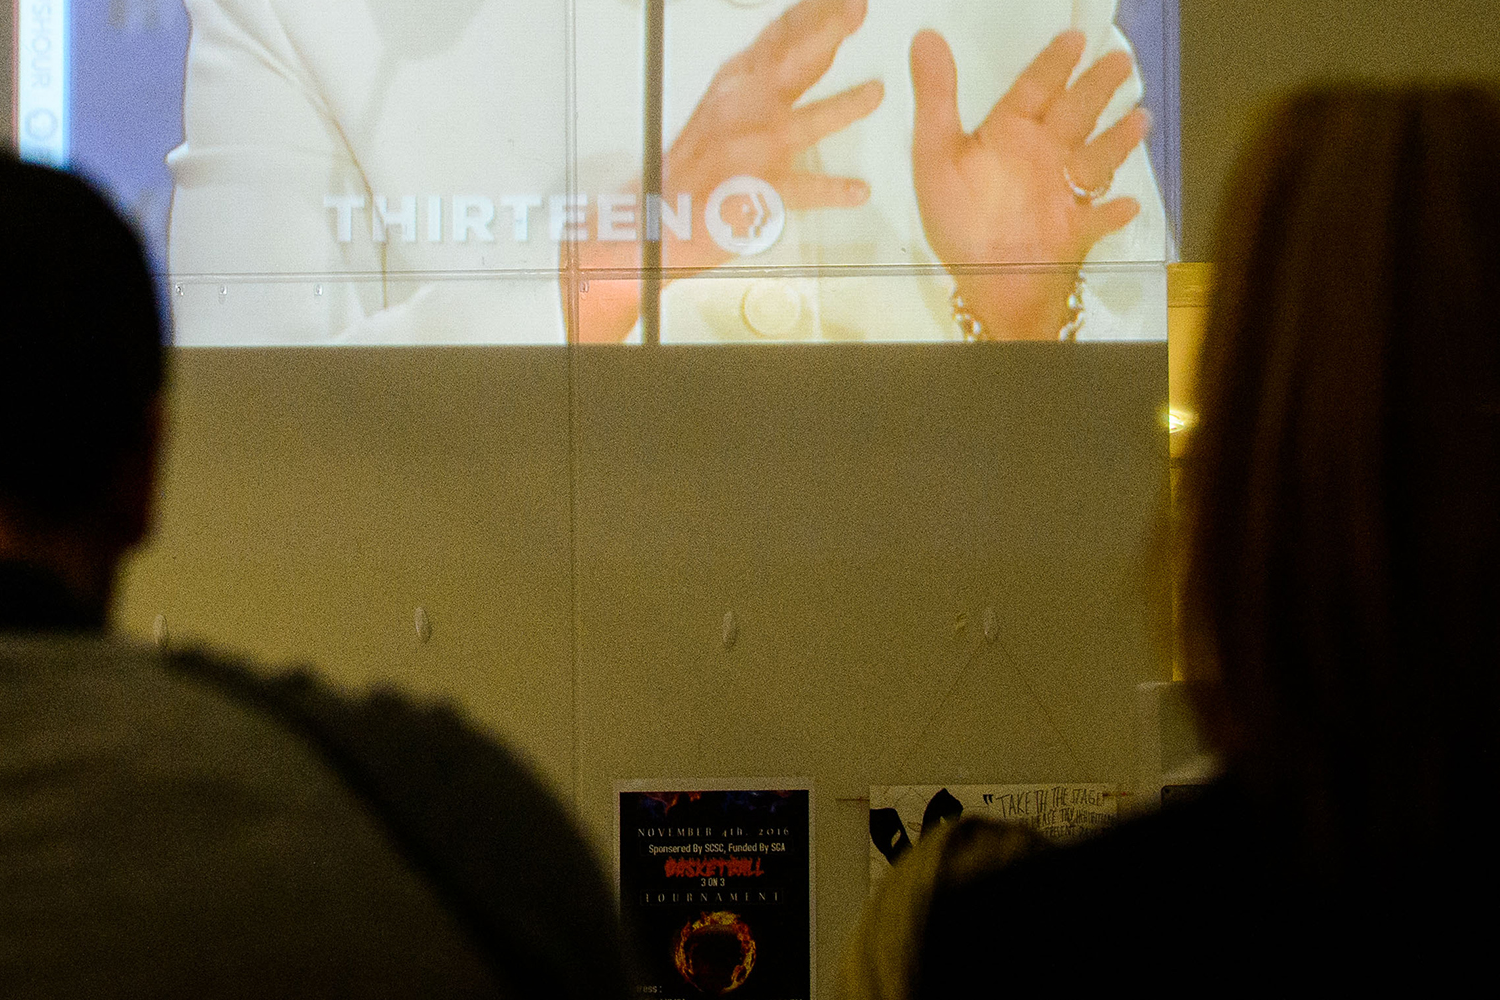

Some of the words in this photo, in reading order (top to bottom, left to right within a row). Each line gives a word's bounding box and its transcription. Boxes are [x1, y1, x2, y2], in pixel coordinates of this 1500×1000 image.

[324, 193, 693, 243] THIRTEEN
[637, 827, 712, 838] NOVEMBER
[758, 826, 790, 837] 2016
[692, 843, 703, 855] By
[728, 842, 758, 852] Funded
[759, 842, 769, 854] By
[664, 855, 765, 877] BASKETBALL
[707, 878, 718, 887] ON
[645, 892, 778, 903] TOURNAMENT
